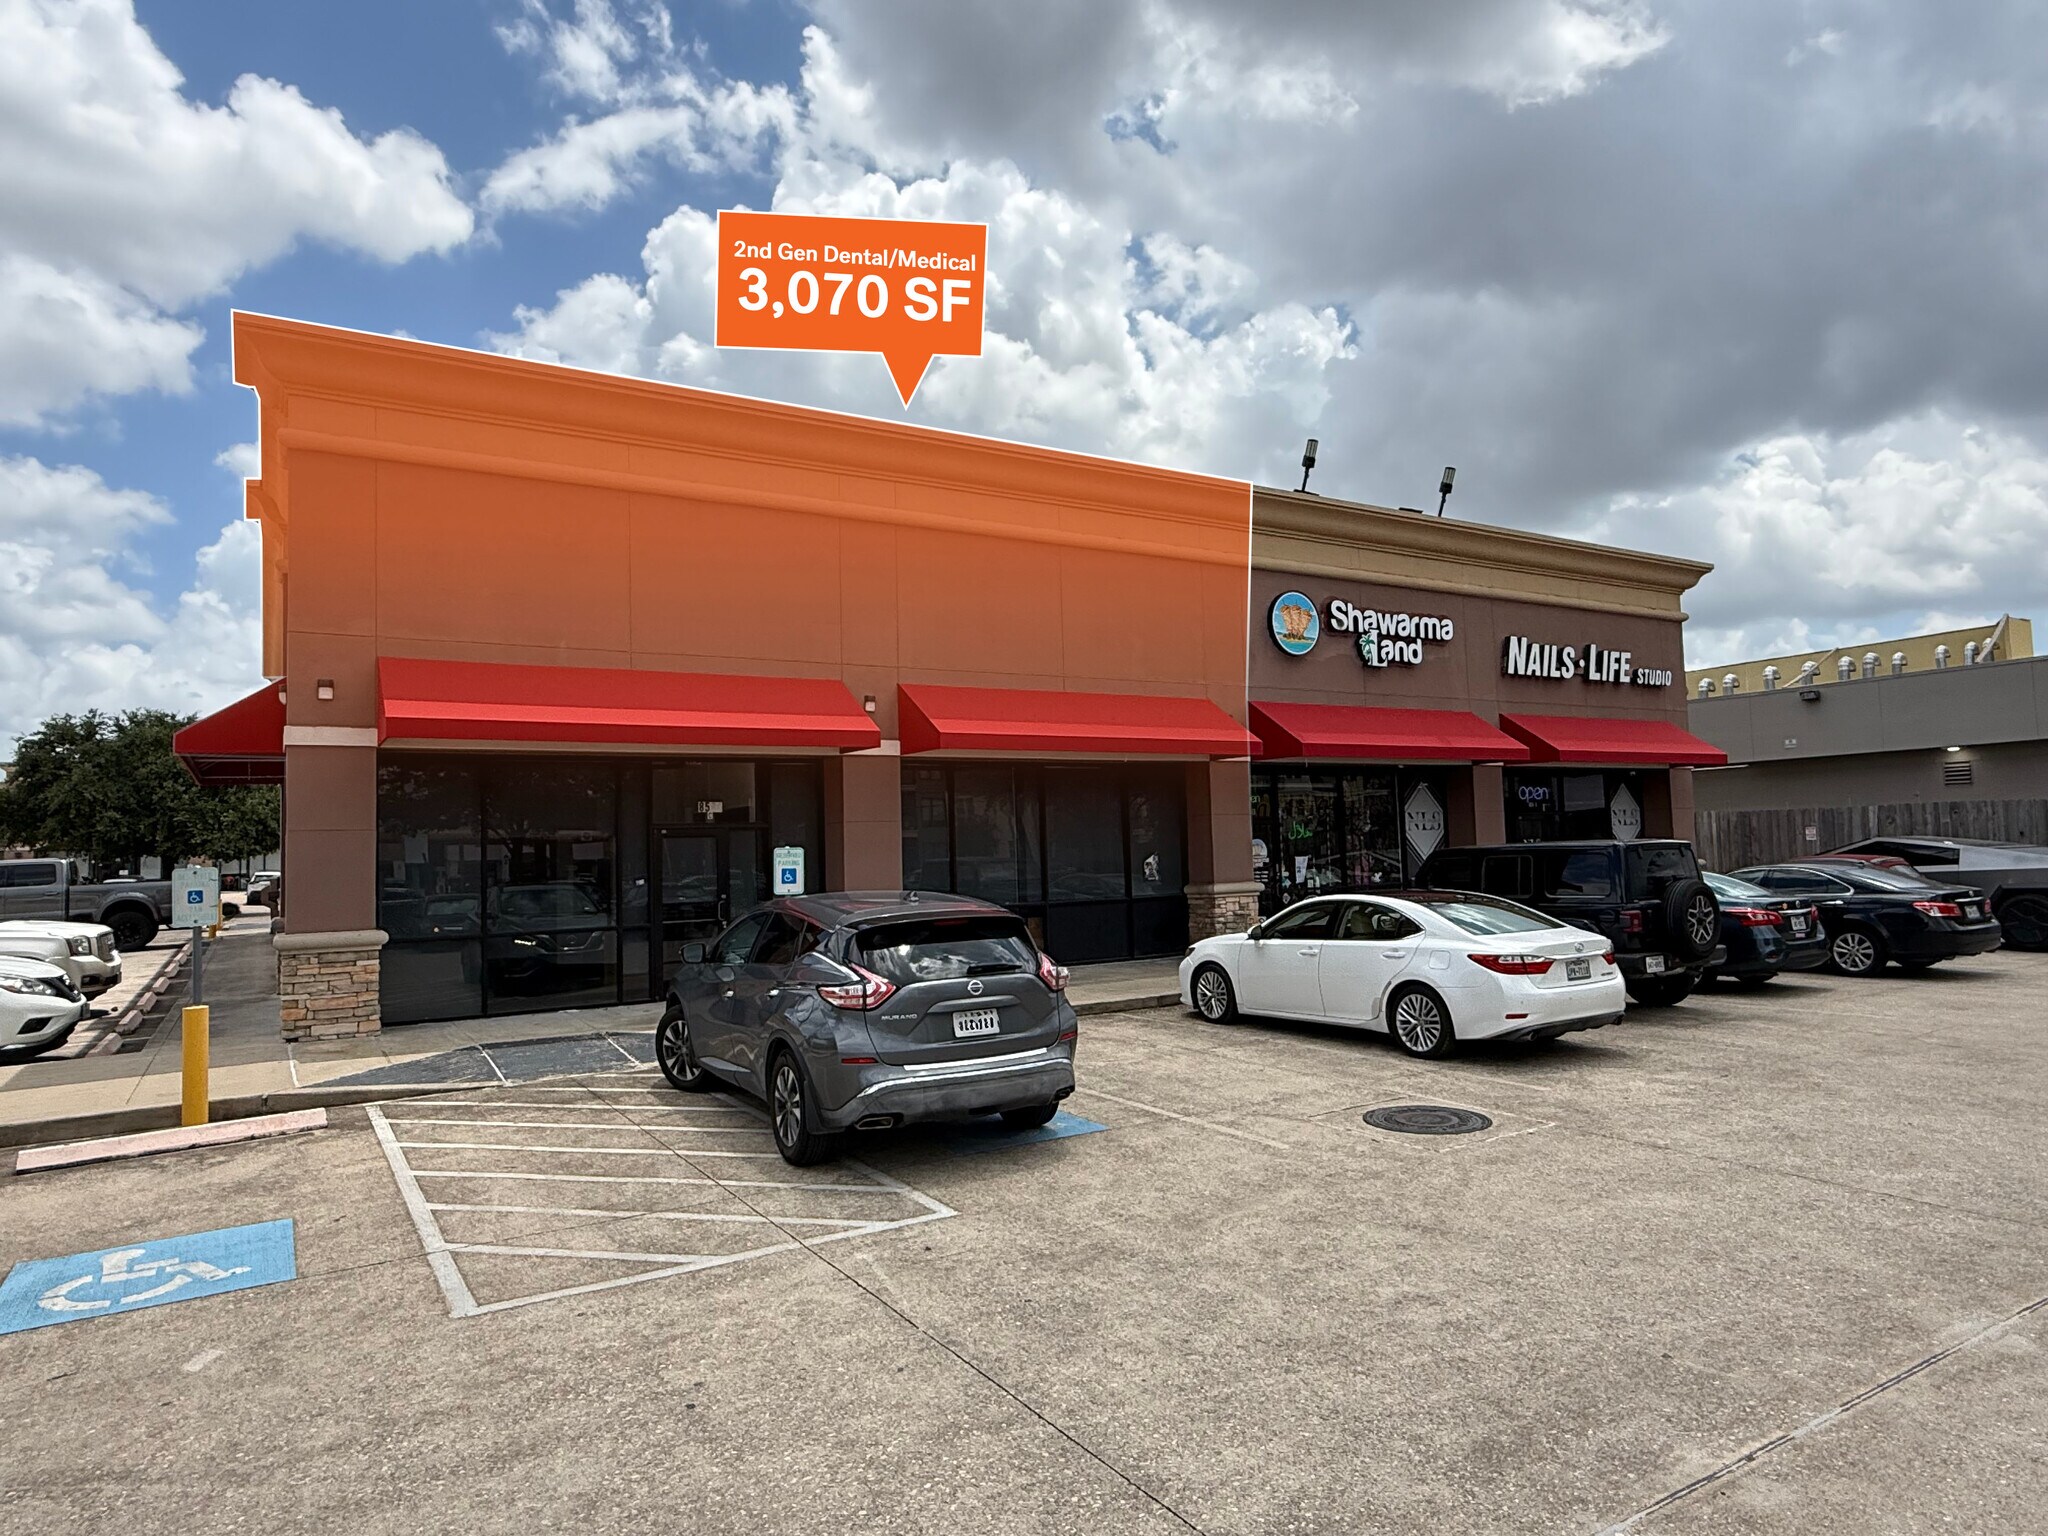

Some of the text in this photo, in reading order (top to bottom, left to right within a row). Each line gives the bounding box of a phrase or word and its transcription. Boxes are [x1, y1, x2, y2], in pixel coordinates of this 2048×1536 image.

[1330, 600, 1454, 641] Shawarma
[1360, 628, 1423, 667] Land
[1507, 635, 1673, 687] NAILS LIFE STUDIO
[1518, 786, 1549, 803] open
[881, 1013, 918, 1021] MURANO
